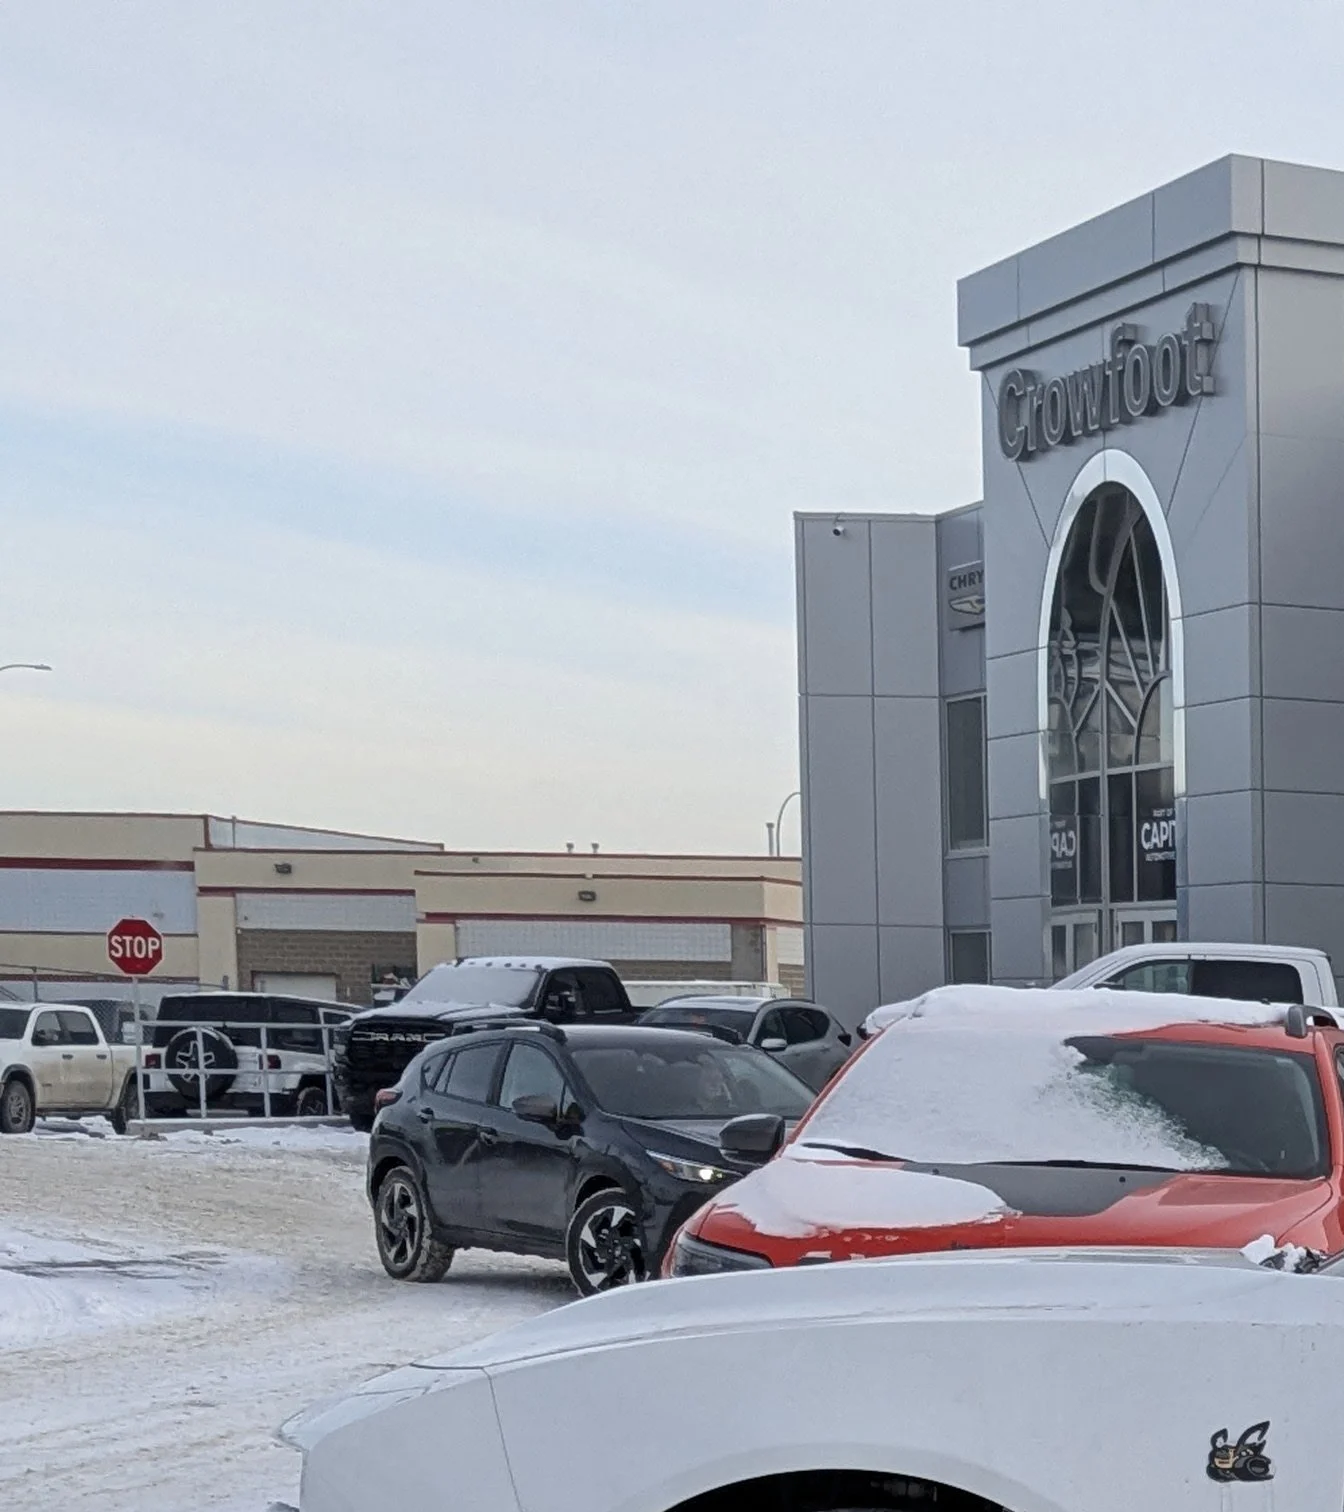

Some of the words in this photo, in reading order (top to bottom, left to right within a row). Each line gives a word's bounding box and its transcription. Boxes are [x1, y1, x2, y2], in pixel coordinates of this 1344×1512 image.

[999, 302, 1216, 462] Crowfoot
[949, 570, 984, 591] CHRY
[110, 935, 160, 959] STOP
